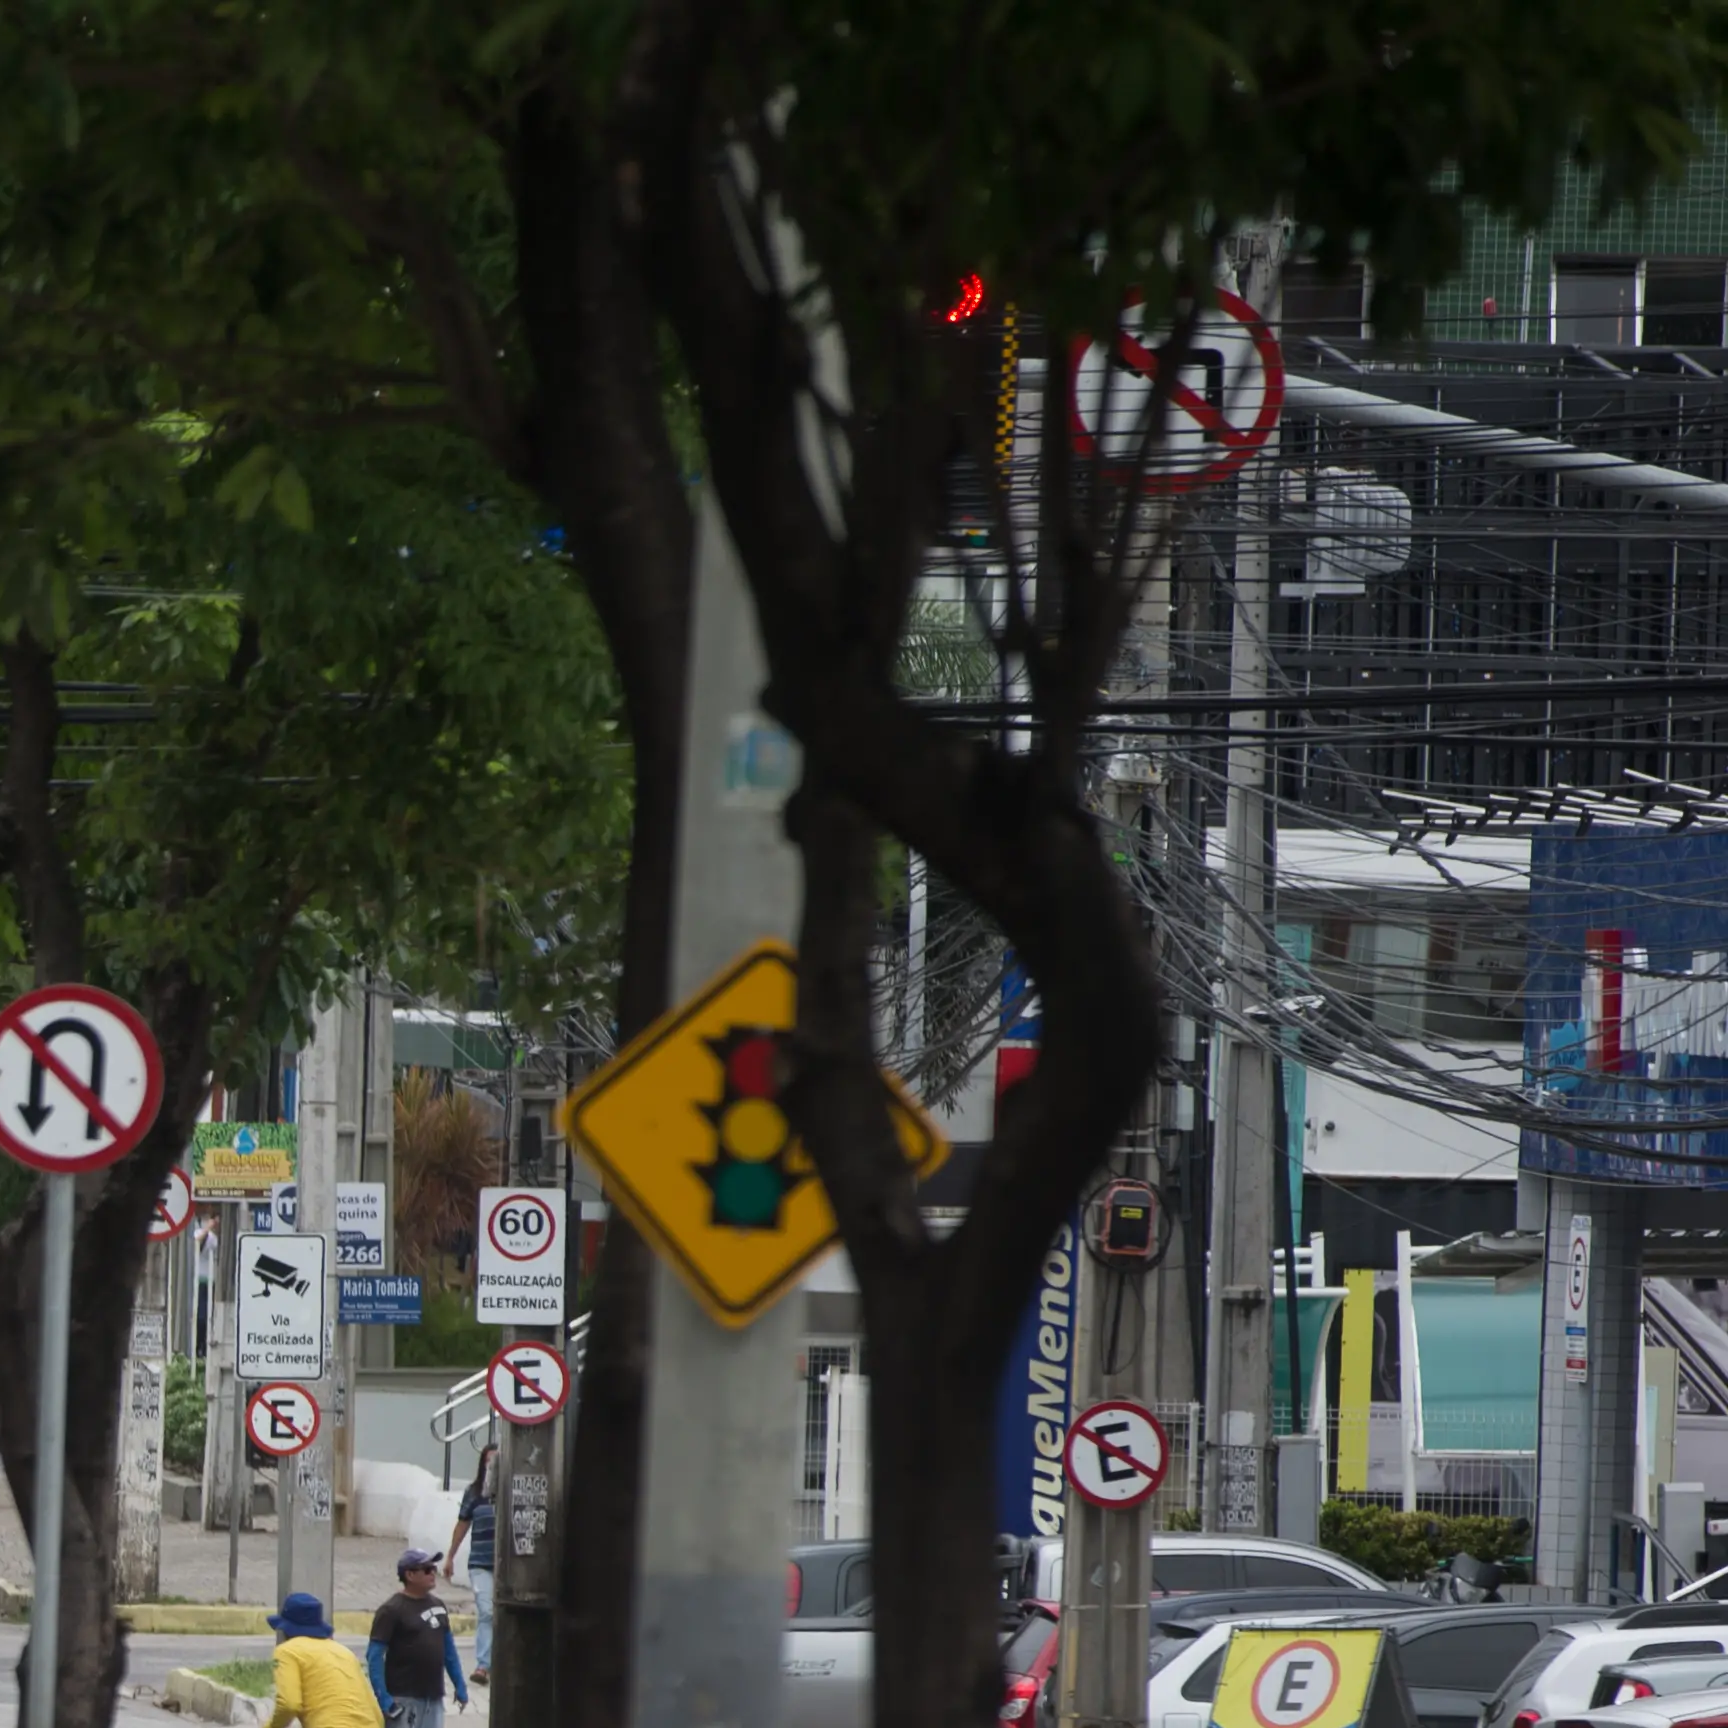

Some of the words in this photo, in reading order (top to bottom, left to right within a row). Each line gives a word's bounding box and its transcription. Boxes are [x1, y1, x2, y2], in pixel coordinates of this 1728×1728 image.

[499, 1208, 543, 1236] 60
[344, 1277, 373, 1297] Maria
[375, 1277, 419, 1297] Tomásia
[480, 1273, 562, 1290] FISCALIZAÇÃO
[482, 1295, 558, 1310] ELETRÔNICA
[271, 1314, 290, 1326] Via
[247, 1333, 313, 1345] Fiscalizada
[241, 1353, 260, 1365] por
[266, 1352, 318, 1364] Câmeras
[1276, 1661, 1314, 1711] E
